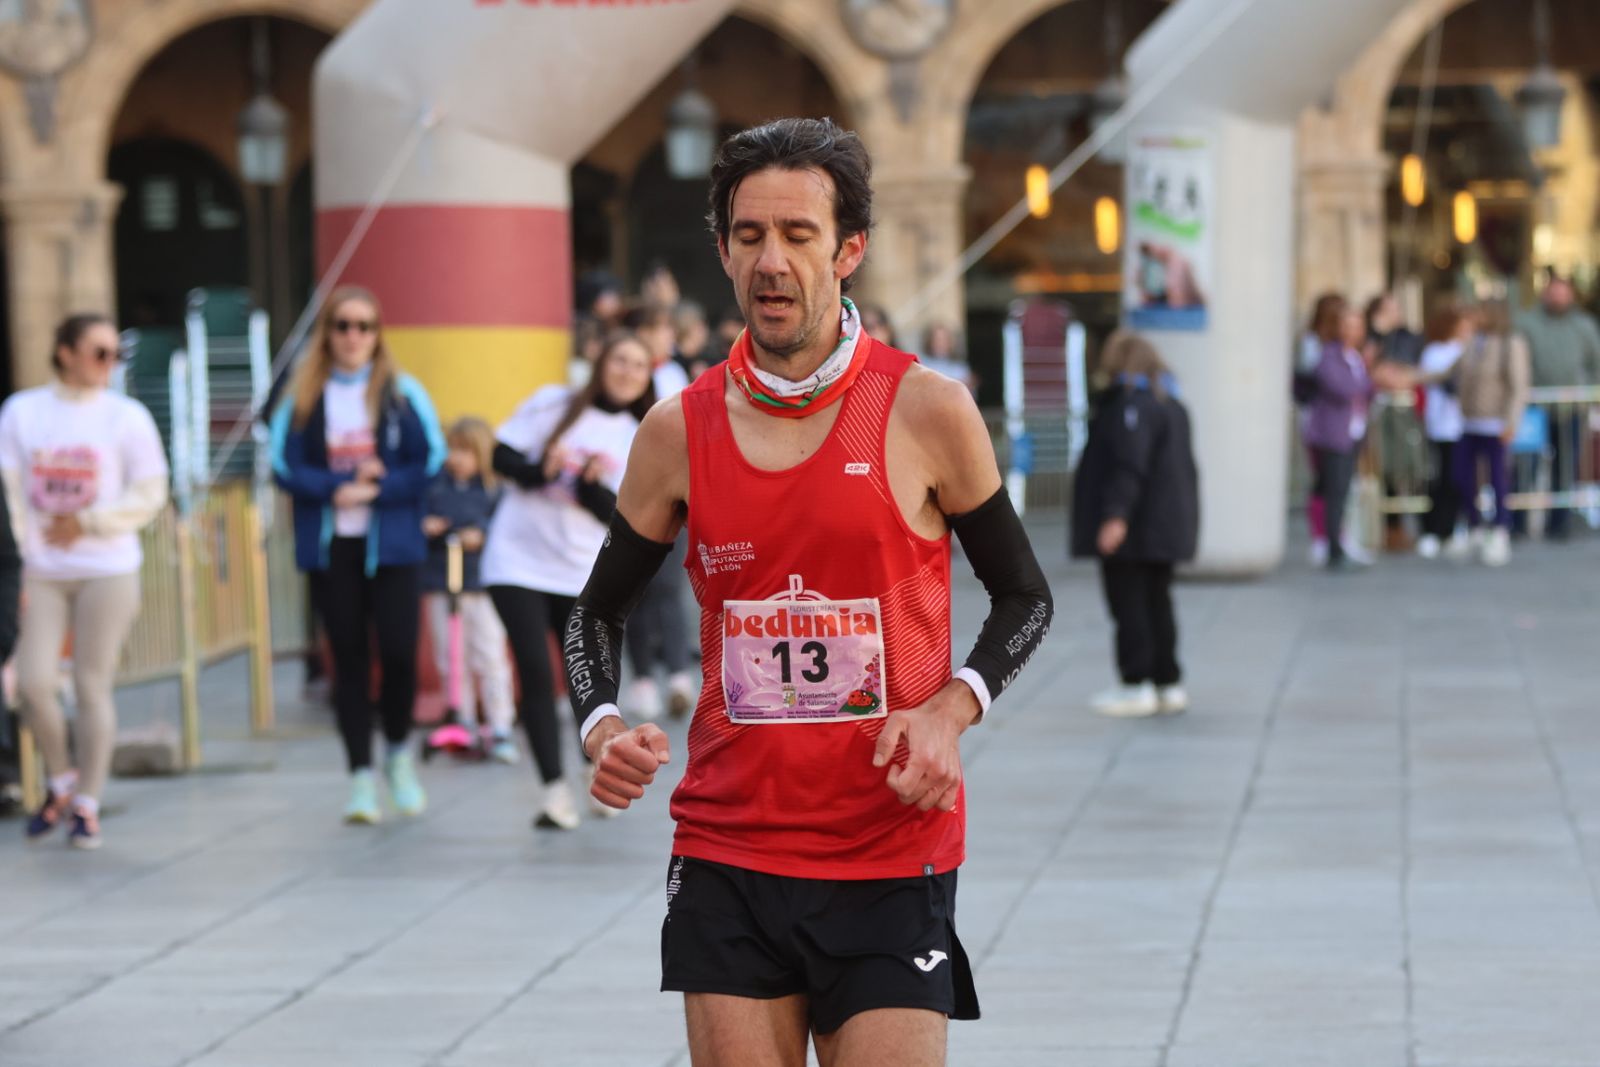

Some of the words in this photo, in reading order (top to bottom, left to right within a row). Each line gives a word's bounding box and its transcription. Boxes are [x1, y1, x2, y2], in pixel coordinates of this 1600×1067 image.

[715, 541, 753, 553] BAÑEZA
[710, 553, 755, 566] PUTACIÓN
[720, 563, 741, 572] LEÓN
[725, 607, 877, 638] bedunia
[1005, 600, 1047, 657] AGRUPACIÓN
[565, 606, 595, 706] MONTAÑERA
[771, 641, 829, 683] 13
[798, 691, 837, 700] Ayuntamiento
[807, 698, 837, 706] Salamanca
